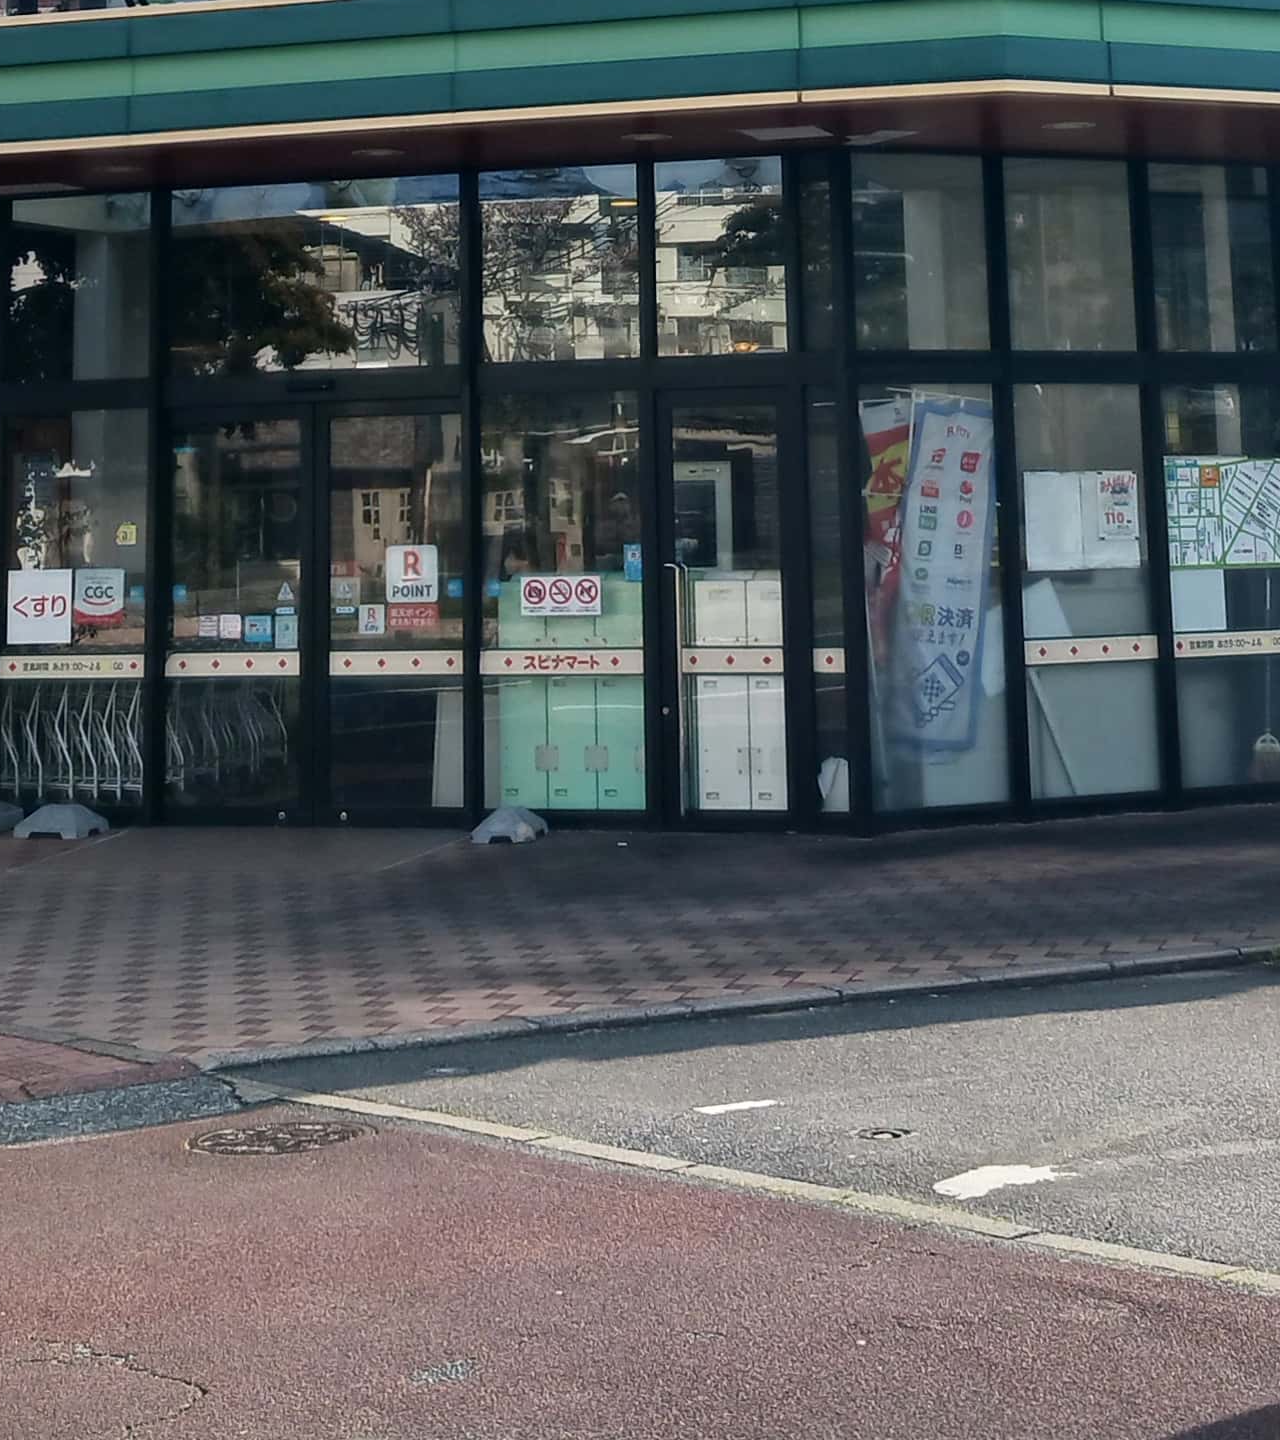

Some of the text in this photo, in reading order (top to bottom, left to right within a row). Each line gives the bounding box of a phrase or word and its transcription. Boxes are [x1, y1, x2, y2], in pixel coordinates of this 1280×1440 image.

[403, 550, 422, 577] R
[84, 586, 114, 599] CGC
[392, 584, 432, 597] POINT
[13, 595, 66, 618] くすり
[524, 655, 600, 670] スピナマート
